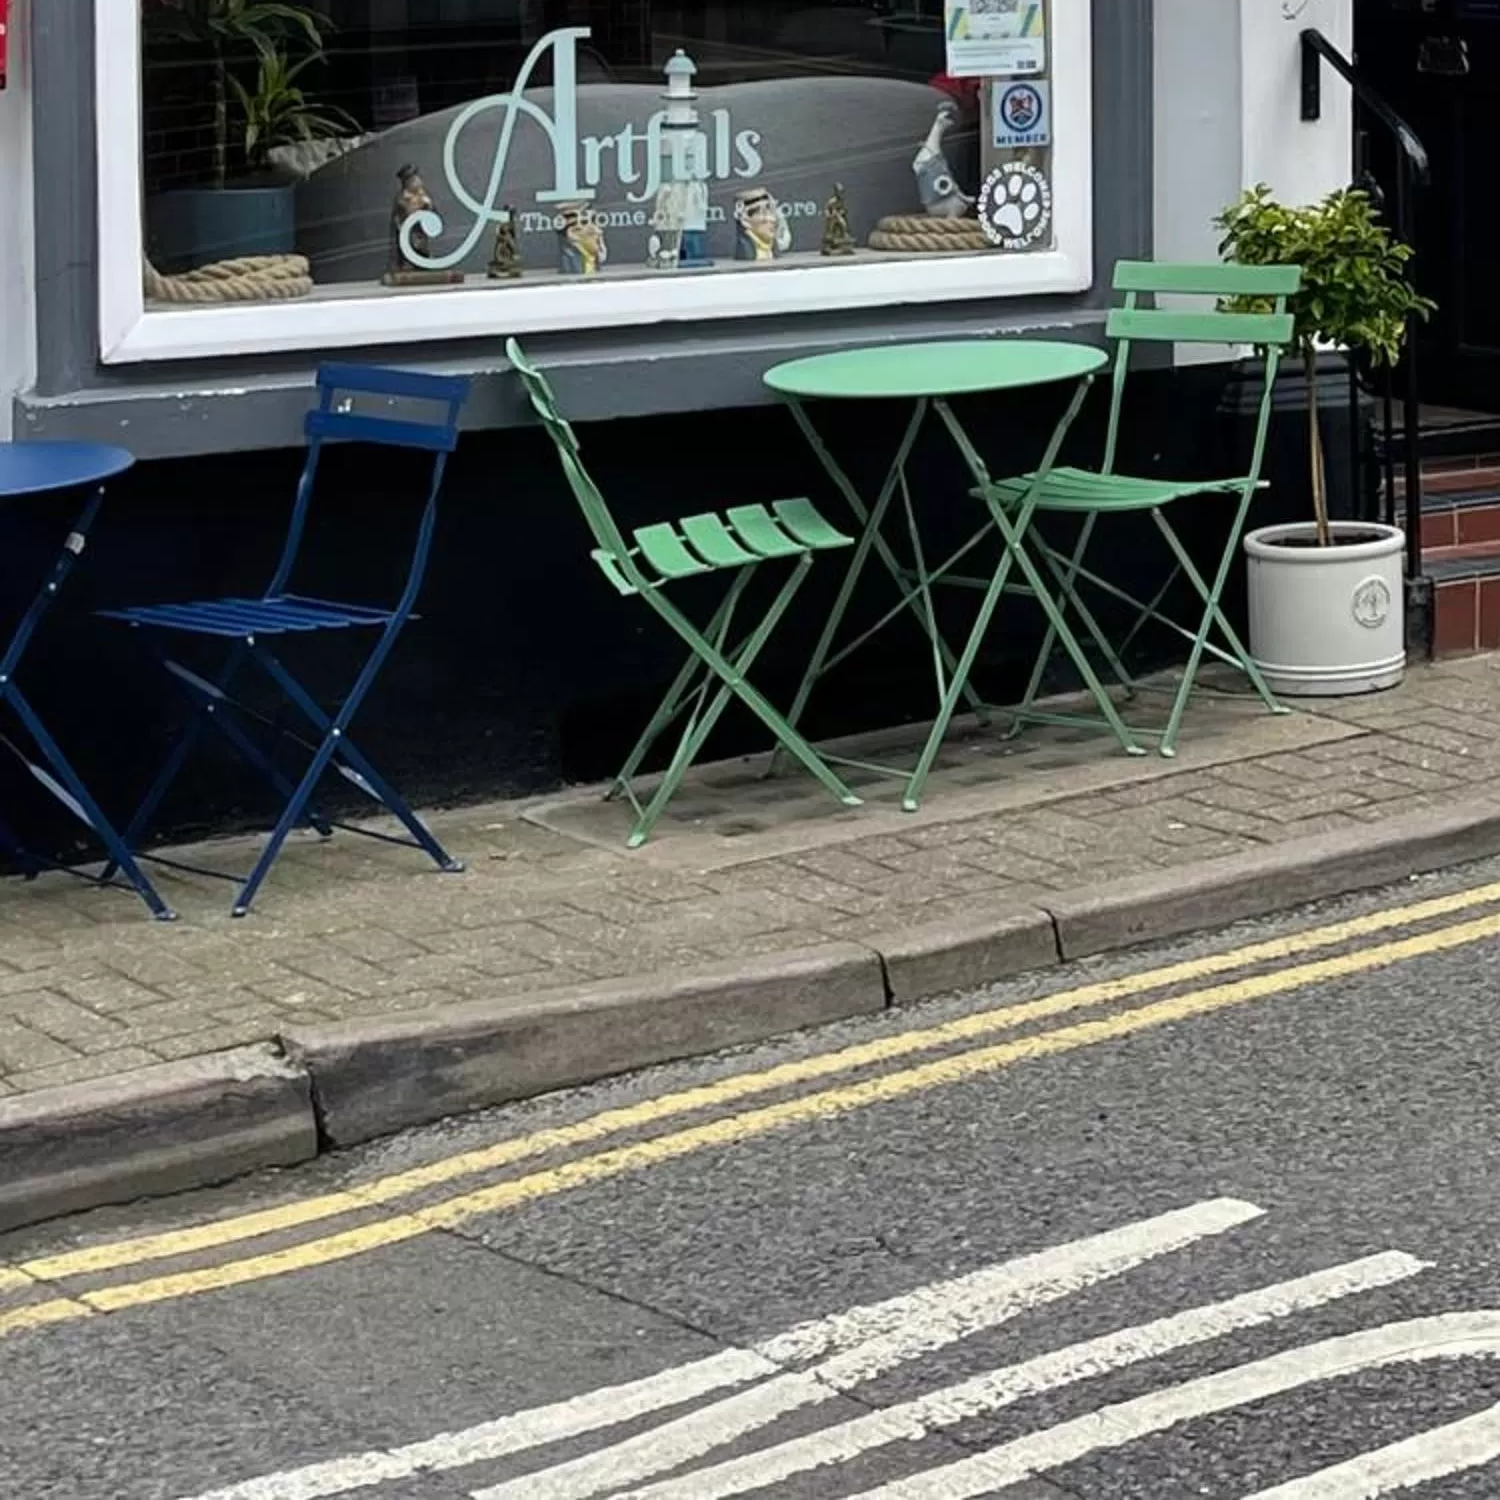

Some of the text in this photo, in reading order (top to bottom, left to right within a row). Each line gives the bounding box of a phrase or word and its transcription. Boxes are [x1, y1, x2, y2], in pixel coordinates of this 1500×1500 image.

[400, 27, 762, 269] Artfuls
[520, 211, 566, 232] The
[576, 209, 646, 228] Home
